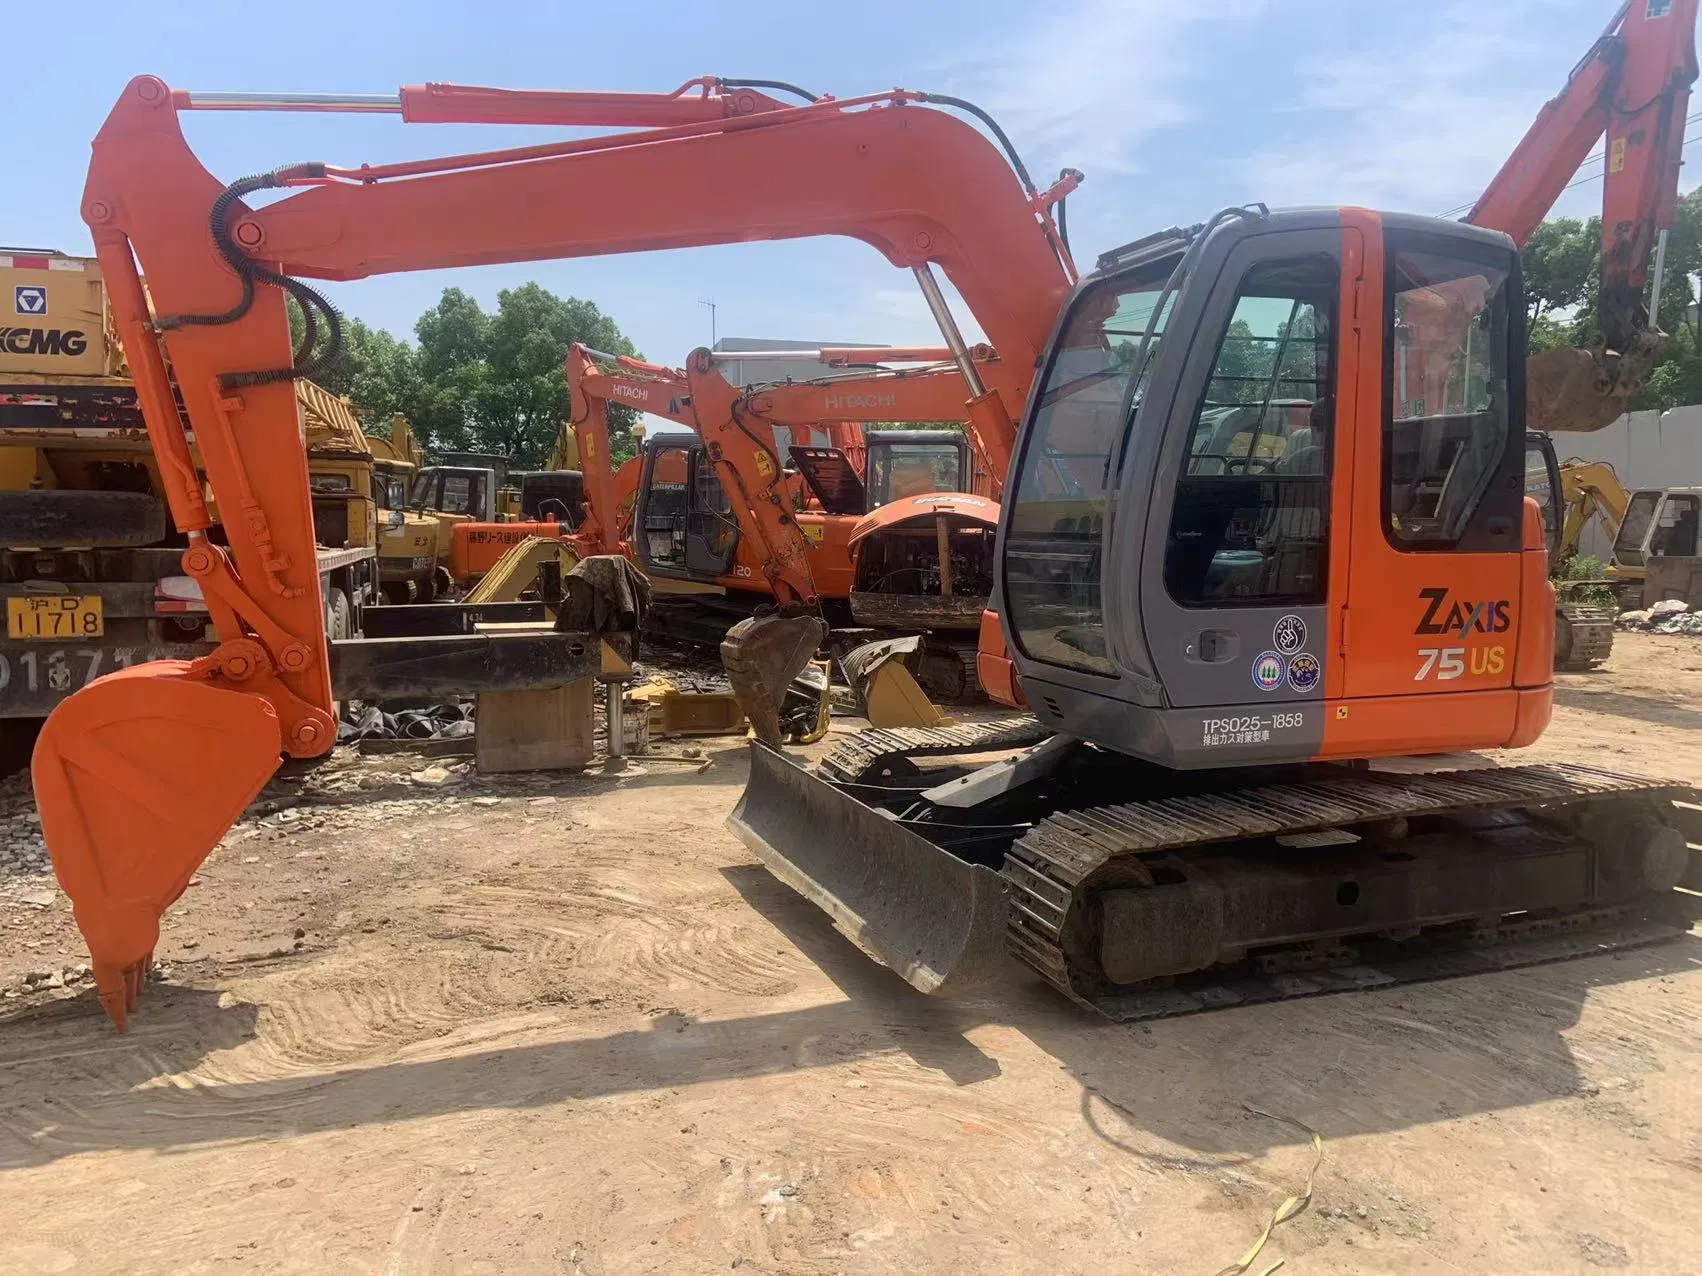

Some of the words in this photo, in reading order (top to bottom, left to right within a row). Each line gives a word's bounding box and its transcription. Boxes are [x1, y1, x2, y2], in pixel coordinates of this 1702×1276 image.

[612, 384, 649, 400] HITACHI
[824, 393, 897, 409] HITACHI
[733, 563, 752, 577] 120
[17, 611, 99, 635] 11718
[1414, 587, 1511, 639] ZAXIS
[1414, 647, 1466, 681] 75
[1470, 645, 1506, 675] US
